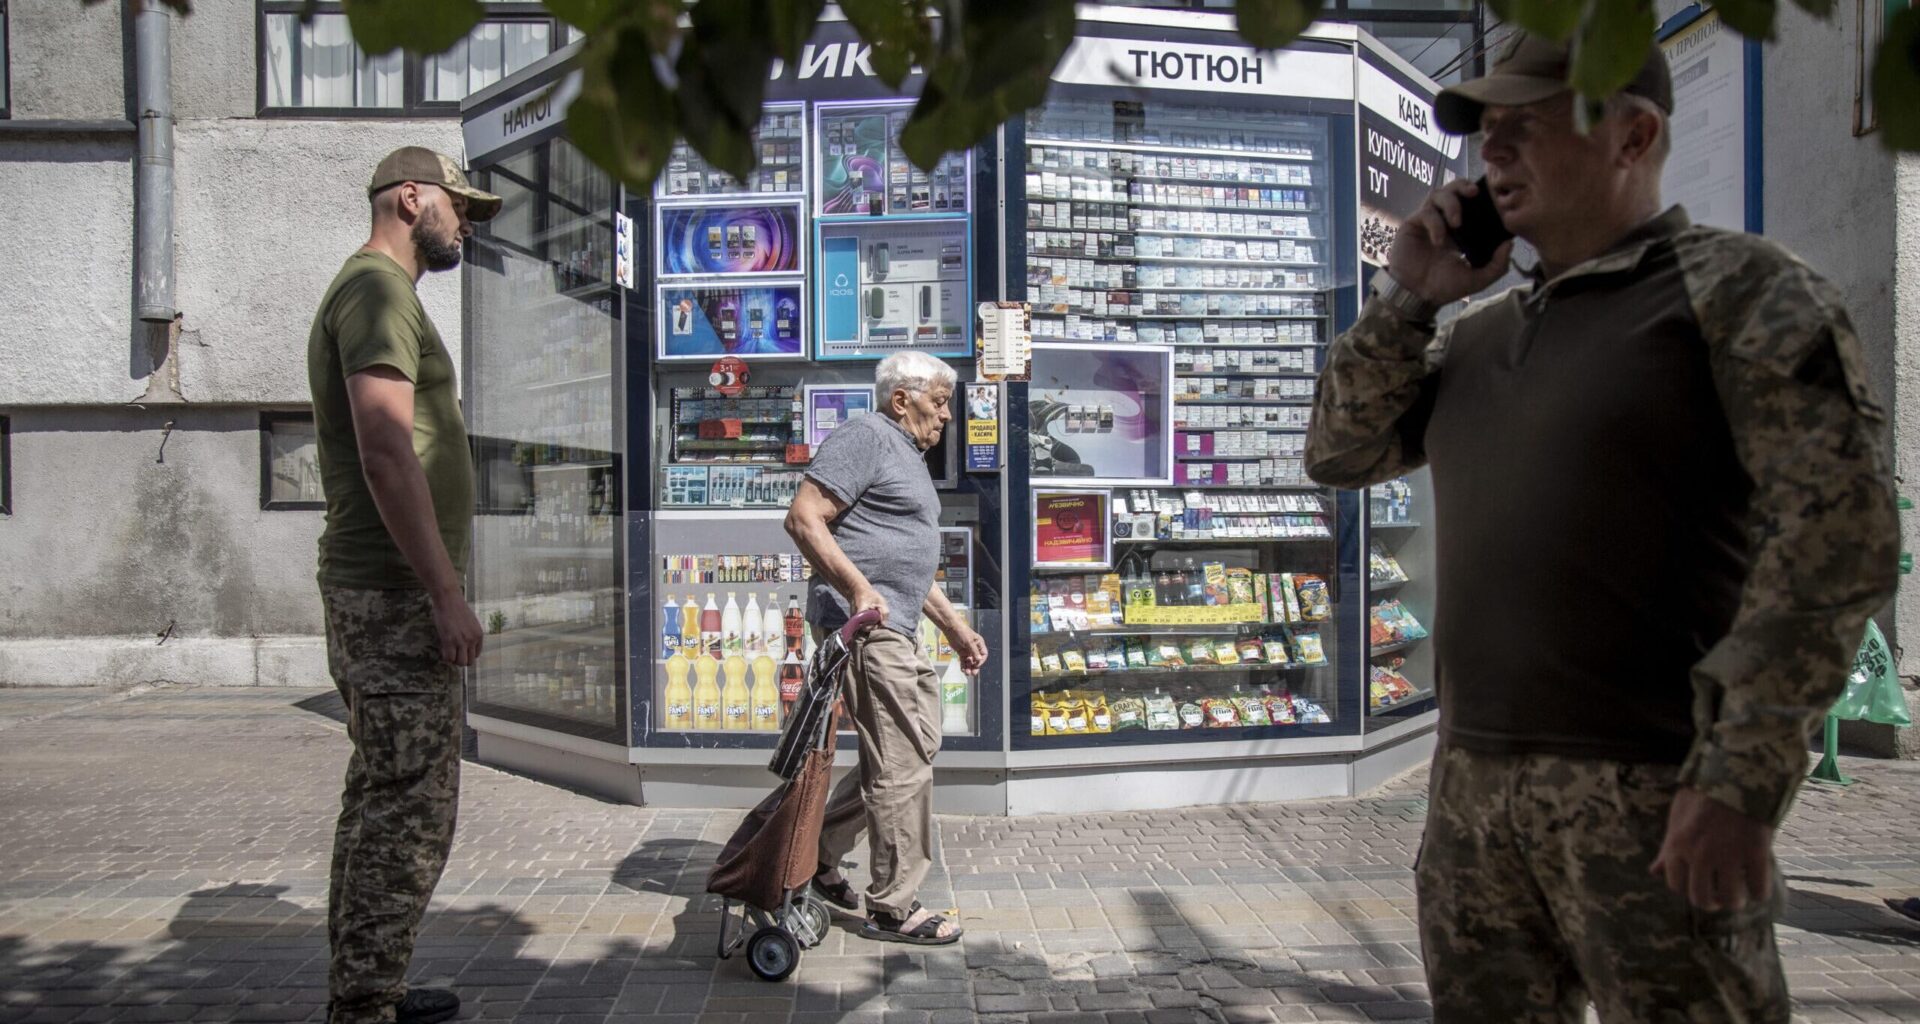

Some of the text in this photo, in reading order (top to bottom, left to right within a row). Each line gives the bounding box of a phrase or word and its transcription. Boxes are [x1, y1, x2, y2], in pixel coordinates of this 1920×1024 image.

[1676, 18, 1723, 57] ПРОПОН
[1128, 50, 1262, 84] ТЮТЮН
[503, 87, 554, 137] НАПОЇ
[1398, 94, 1429, 135] КАВА
[1368, 127, 1435, 186] КУПУЙ КАВУ
[1368, 165, 1389, 198] ТУТ
[829, 288, 854, 296] IQOS
